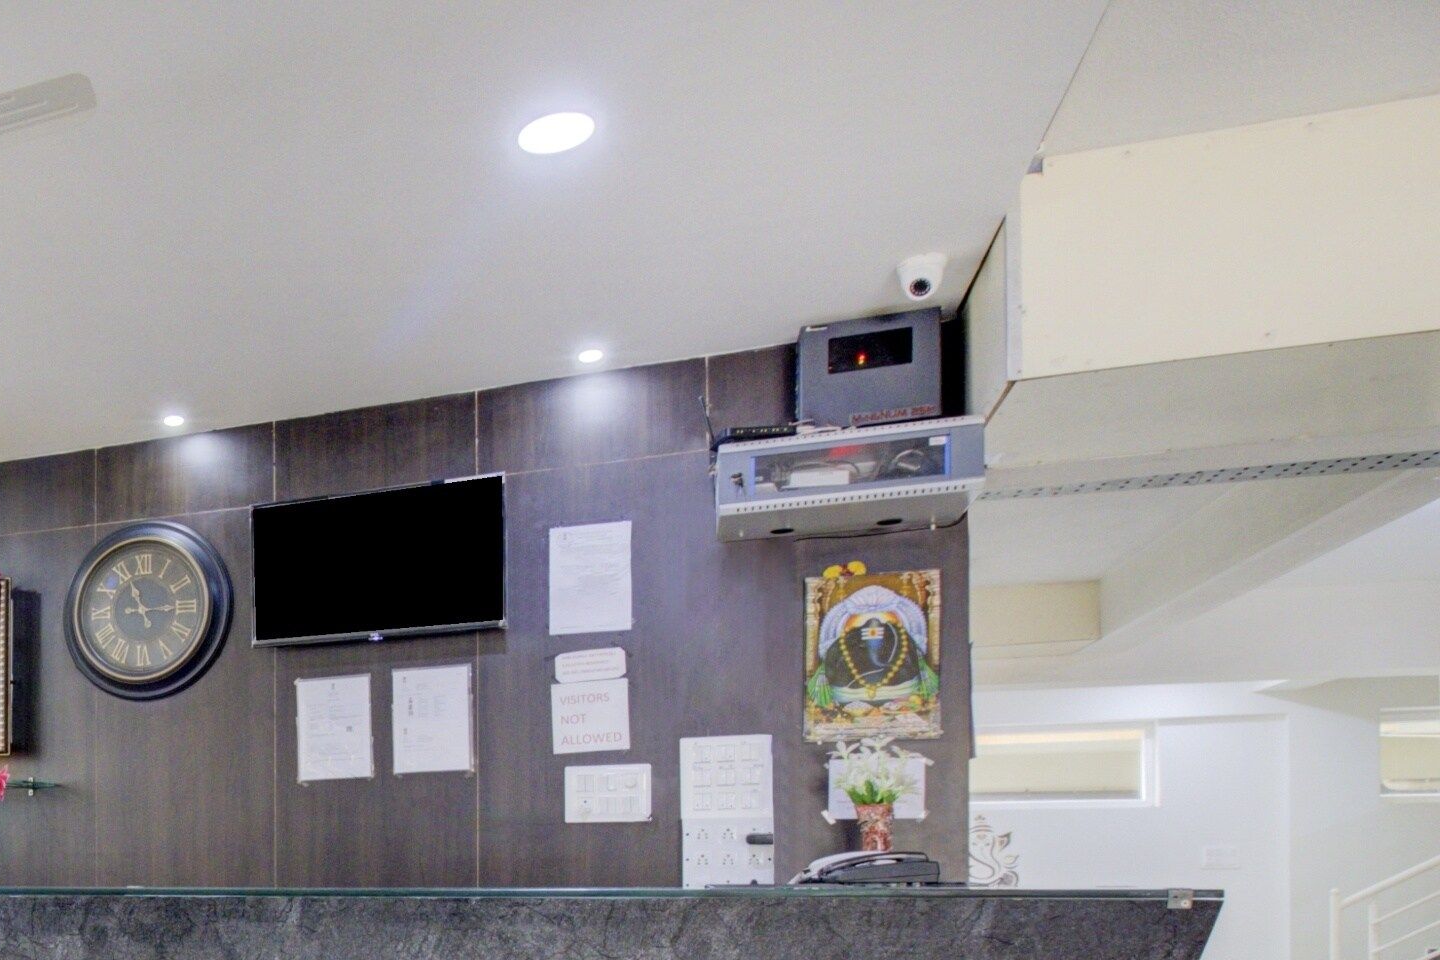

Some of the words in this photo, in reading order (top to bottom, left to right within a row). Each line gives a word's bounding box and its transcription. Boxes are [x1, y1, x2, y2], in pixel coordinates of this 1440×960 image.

[112, 561, 132, 584] XI
[135, 554, 152, 575] XII
[158, 559, 171, 578] I
[96, 582, 117, 599] X
[169, 574, 191, 594] II
[175, 598, 197, 615] III
[136, 644, 152, 667] VI
[159, 640, 173, 660] V
[560, 692, 610, 705] VISITORS
[560, 713, 587, 725] NOT
[561, 732, 622, 745] ALLOWED
